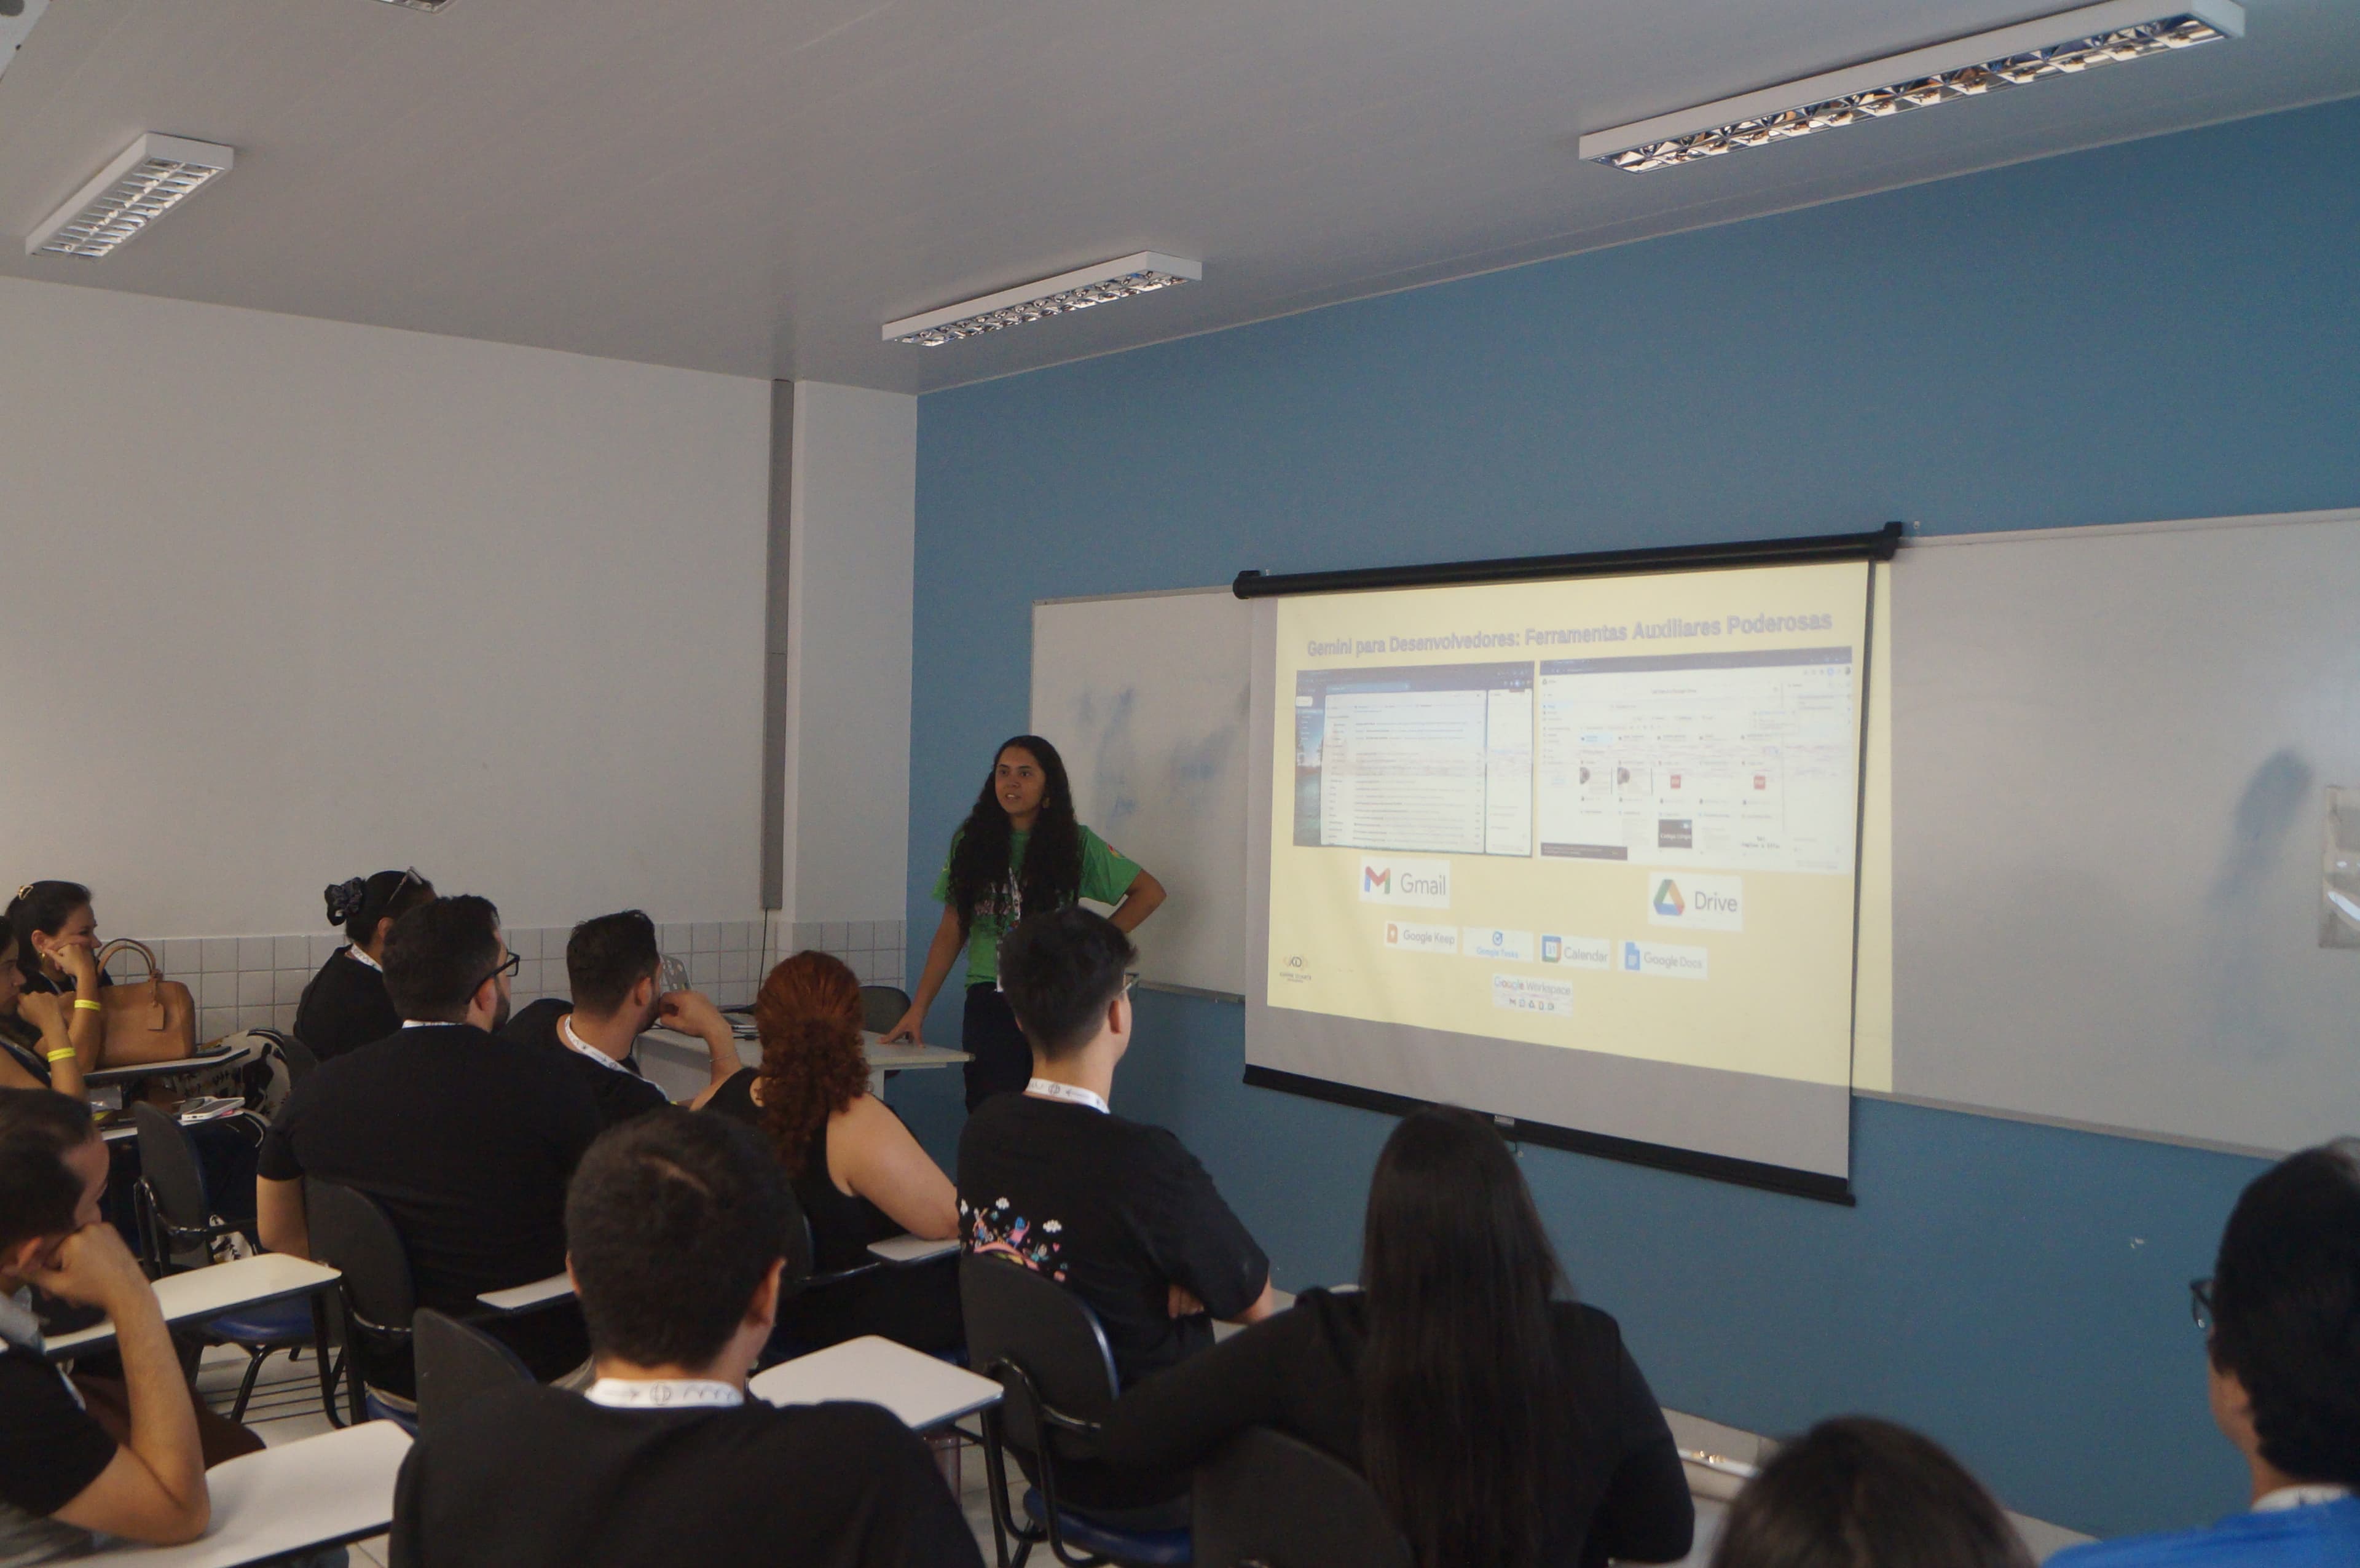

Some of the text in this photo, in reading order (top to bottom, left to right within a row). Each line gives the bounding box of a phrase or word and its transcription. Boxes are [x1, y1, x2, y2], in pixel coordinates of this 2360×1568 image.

[1307, 613, 1832, 657] Gemini para Desenvolvedores: Ferramentas Auxiliares Poderosas
[1401, 872, 1446, 895] Gmail
[1694, 891, 1738, 912] Drive
[1403, 930, 1455, 946] Google Keep
[1476, 946, 1499, 957] Google
[1564, 946, 1608, 963] Calendar
[1644, 952, 1702, 969] Google Docs
[1494, 976, 1571, 995] Google Workspace
